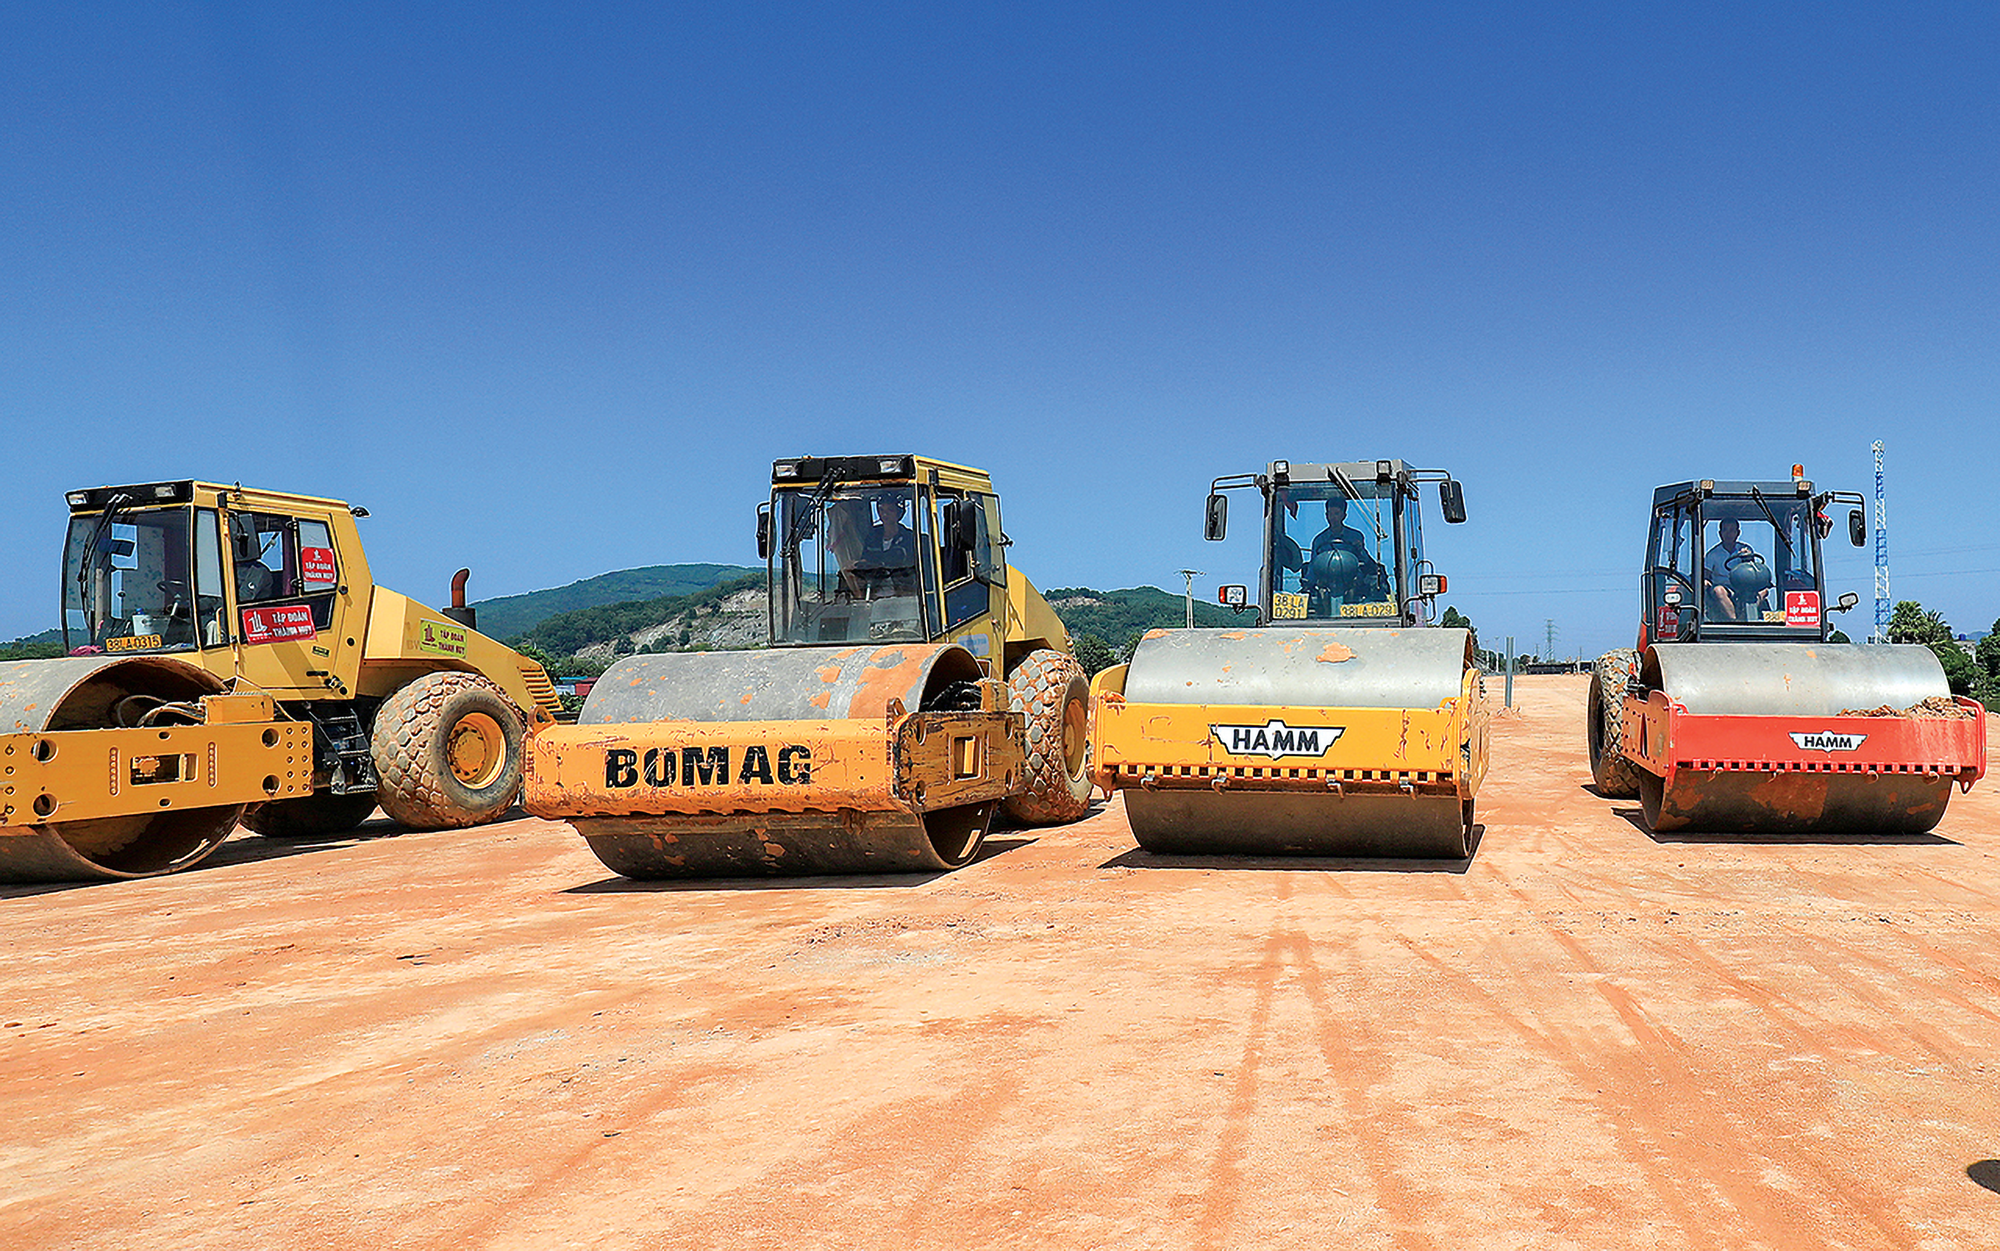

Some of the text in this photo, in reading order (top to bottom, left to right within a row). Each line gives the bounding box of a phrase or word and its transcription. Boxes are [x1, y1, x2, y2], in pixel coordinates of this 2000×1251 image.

[1232, 729, 1319, 752] HAMM
[1804, 736, 1852, 748] HAMM
[606, 745, 811, 787] BOMAG
